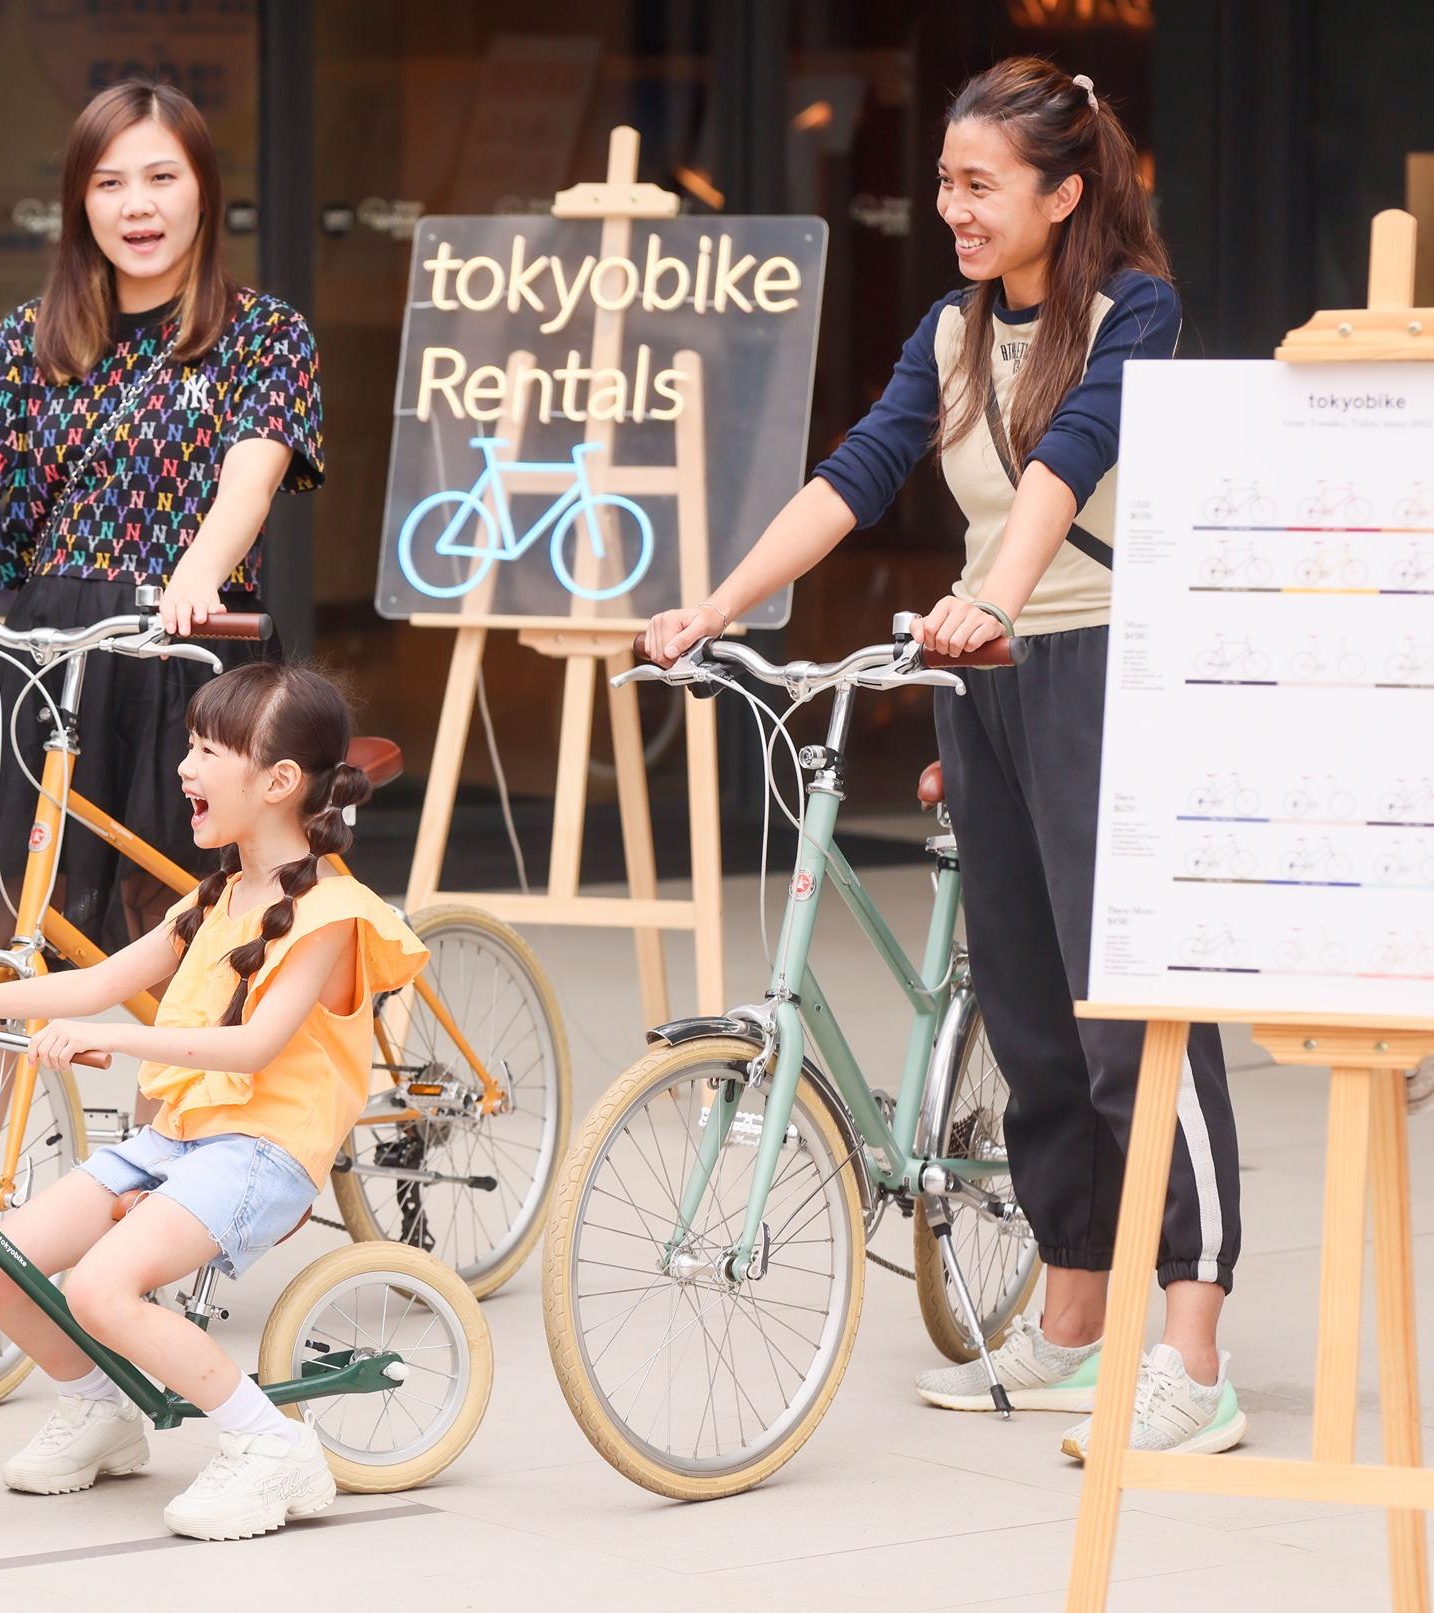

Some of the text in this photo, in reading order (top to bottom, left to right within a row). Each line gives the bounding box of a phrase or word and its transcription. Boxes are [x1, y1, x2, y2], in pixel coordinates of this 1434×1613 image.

[422, 233, 802, 334] tokyobike
[416, 344, 687, 424] Rentals
[1309, 393, 1406, 412] tokyobike
